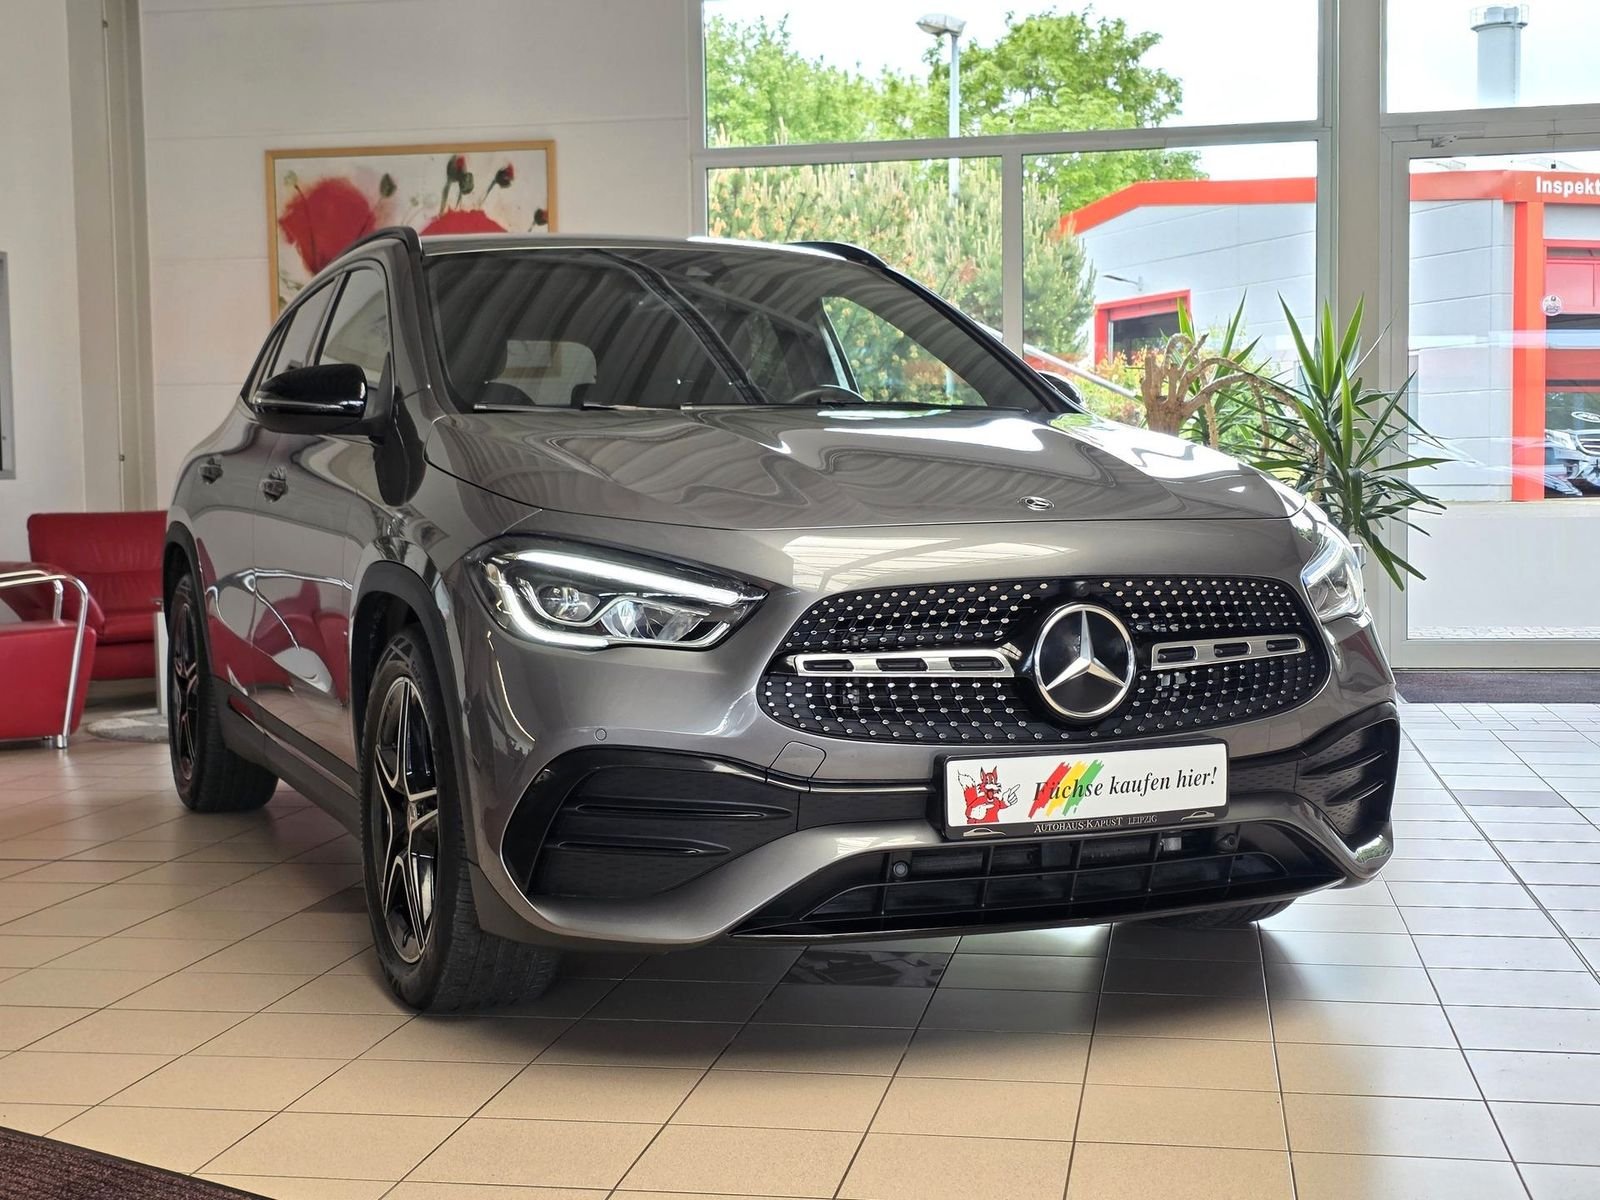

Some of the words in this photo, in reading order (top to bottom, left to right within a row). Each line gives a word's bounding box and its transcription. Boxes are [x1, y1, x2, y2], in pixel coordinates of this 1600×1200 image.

[1033, 778, 1103, 801] Füchse
[1109, 772, 1171, 797] kaufen
[1176, 766, 1217, 788] hier!
[1128, 815, 1158, 825] LEIPZIG
